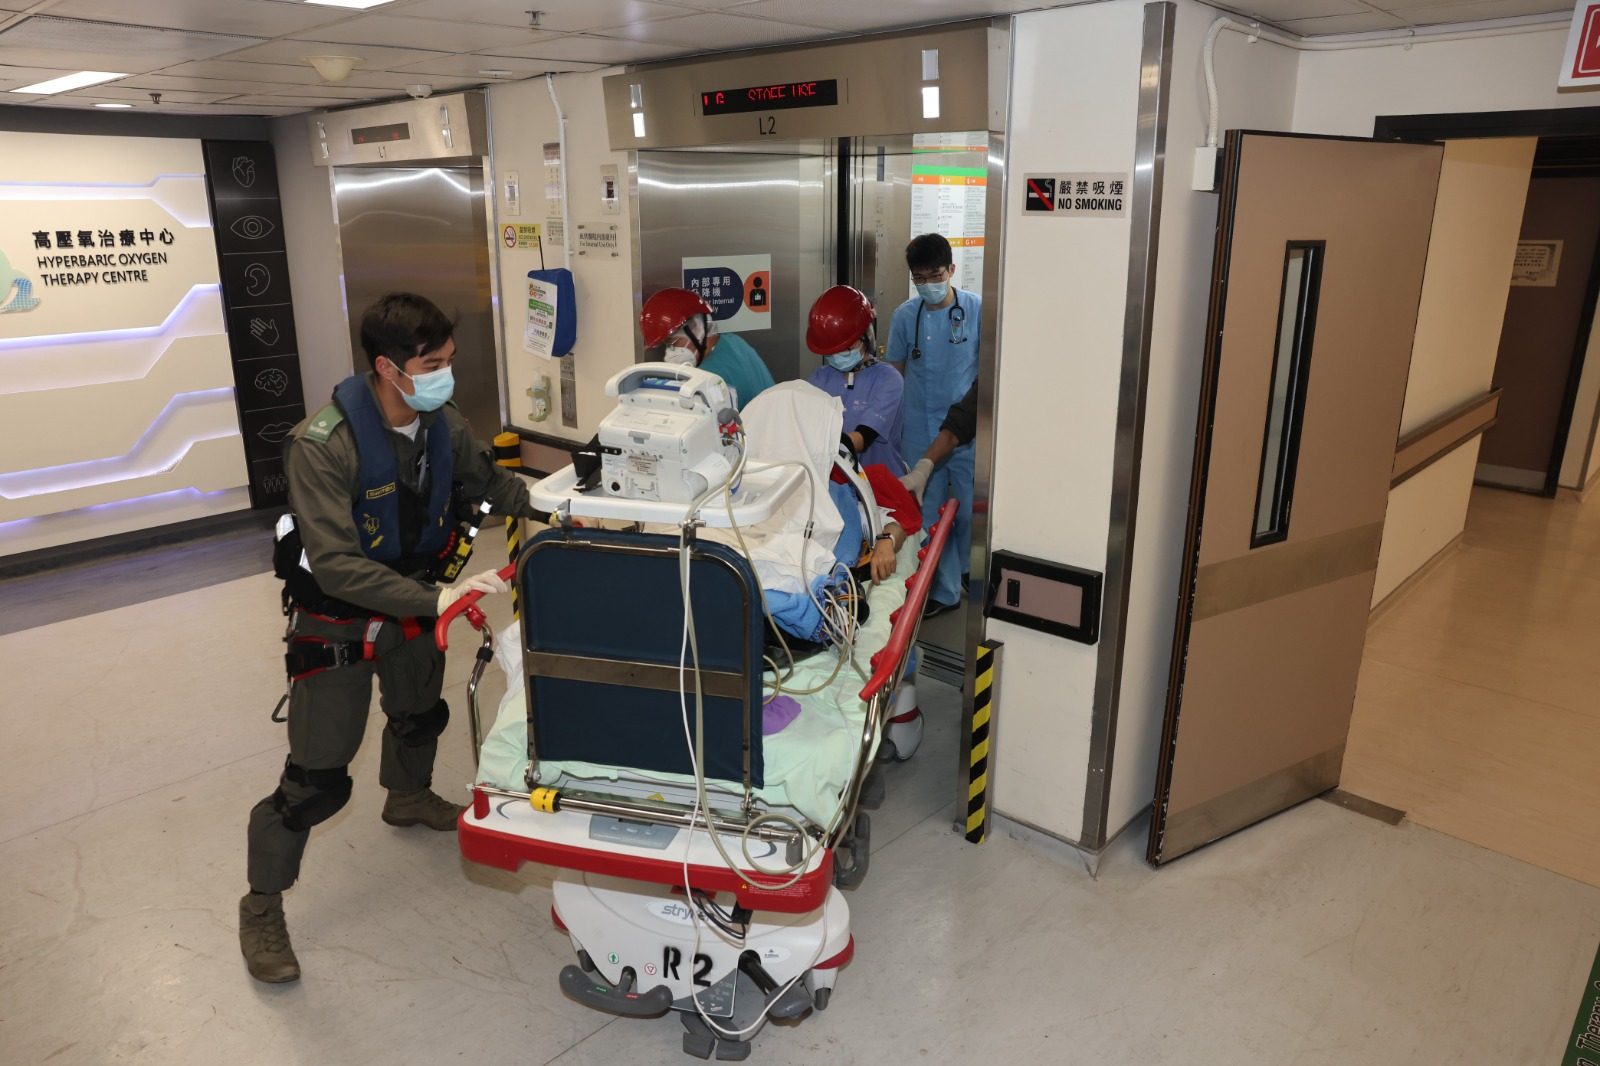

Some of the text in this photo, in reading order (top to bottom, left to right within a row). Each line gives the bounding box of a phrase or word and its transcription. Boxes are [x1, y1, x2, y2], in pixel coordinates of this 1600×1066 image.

[759, 116, 776, 135] L2
[1059, 180, 1124, 195] 嚴禁吸煙
[1058, 198, 1122, 211] NO SMOKING
[32, 228, 175, 249] 高壓氧治療中心
[37, 252, 168, 269] HYPERBARIC OXYGEN
[40, 269, 149, 287] THERAPY CENTRE
[691, 276, 731, 288] 內部專用
[712, 297, 735, 305] Internal
